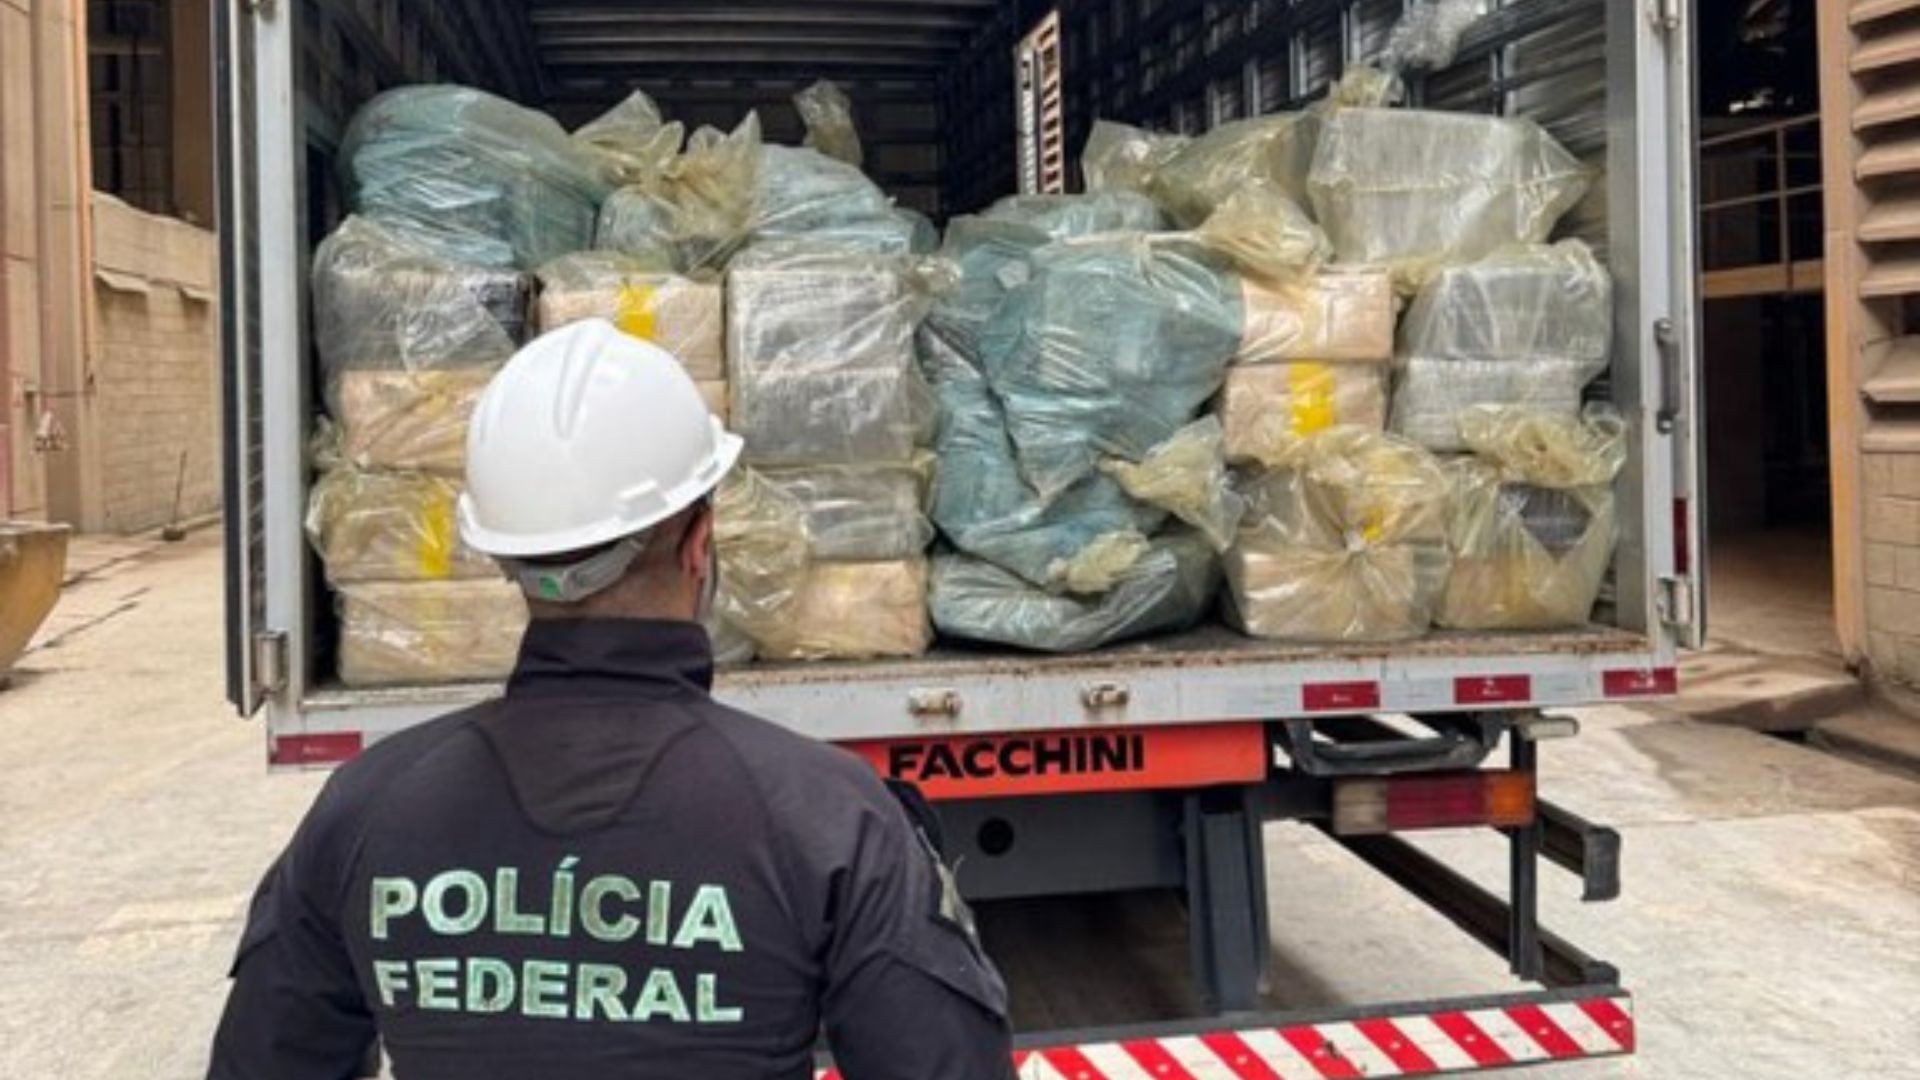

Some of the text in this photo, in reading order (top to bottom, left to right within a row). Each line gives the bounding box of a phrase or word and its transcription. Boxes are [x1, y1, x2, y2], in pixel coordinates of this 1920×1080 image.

[889, 734, 1143, 780] FACCHINI
[370, 856, 743, 952] POLÍCIA
[373, 957, 743, 1022] FEDERAL
